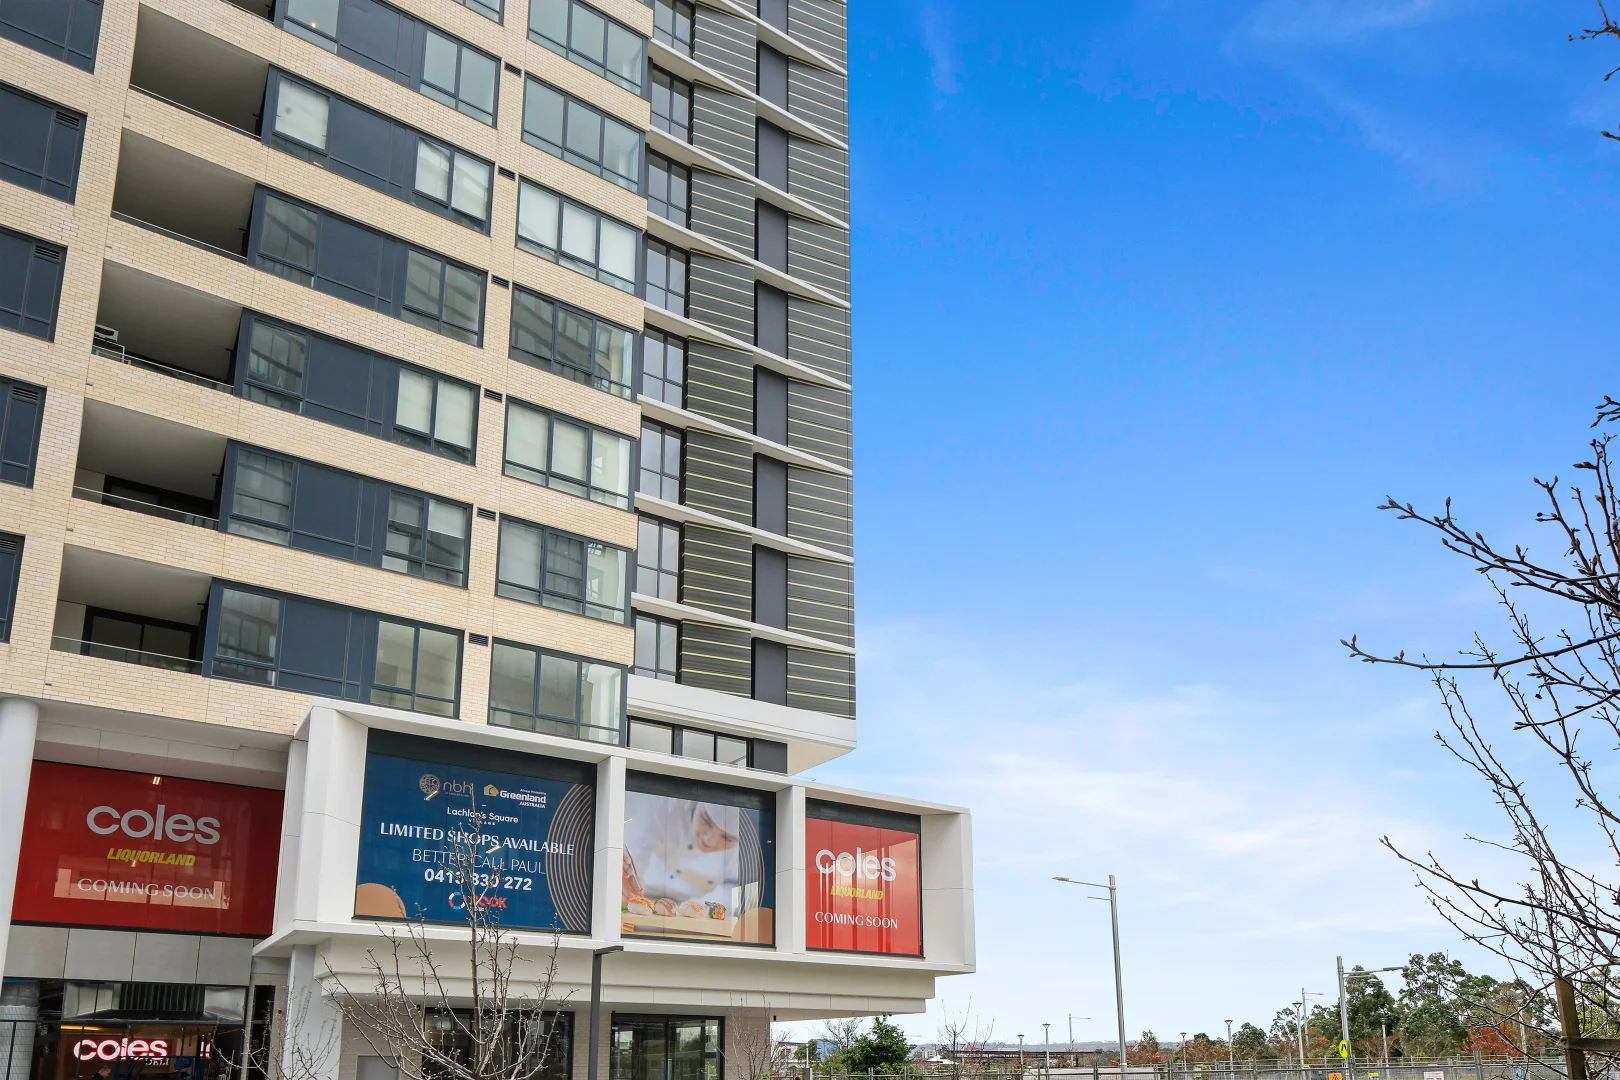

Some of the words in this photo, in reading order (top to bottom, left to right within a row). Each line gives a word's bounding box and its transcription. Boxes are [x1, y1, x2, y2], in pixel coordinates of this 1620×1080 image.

[500, 790, 546, 804] Greenland
[519, 801, 546, 809] AUSTRALIA
[86, 804, 220, 845] coles
[489, 812, 519, 824] Square
[380, 822, 444, 841] LIMITED
[447, 830, 500, 848] SHOPS
[501, 836, 575, 856] AVAILABLE
[107, 847, 196, 867] LIQUORLAND
[412, 848, 467, 867] BETTER
[511, 858, 546, 875] PAUL
[815, 846, 897, 882] coles
[77, 878, 159, 896] COMING
[162, 884, 216, 900] SOON
[504, 876, 533, 891] 272
[830, 885, 884, 901] LIQUORLAND
[815, 911, 864, 926] COMING
[865, 915, 898, 929] SOON
[73, 1037, 168, 1060] coles
